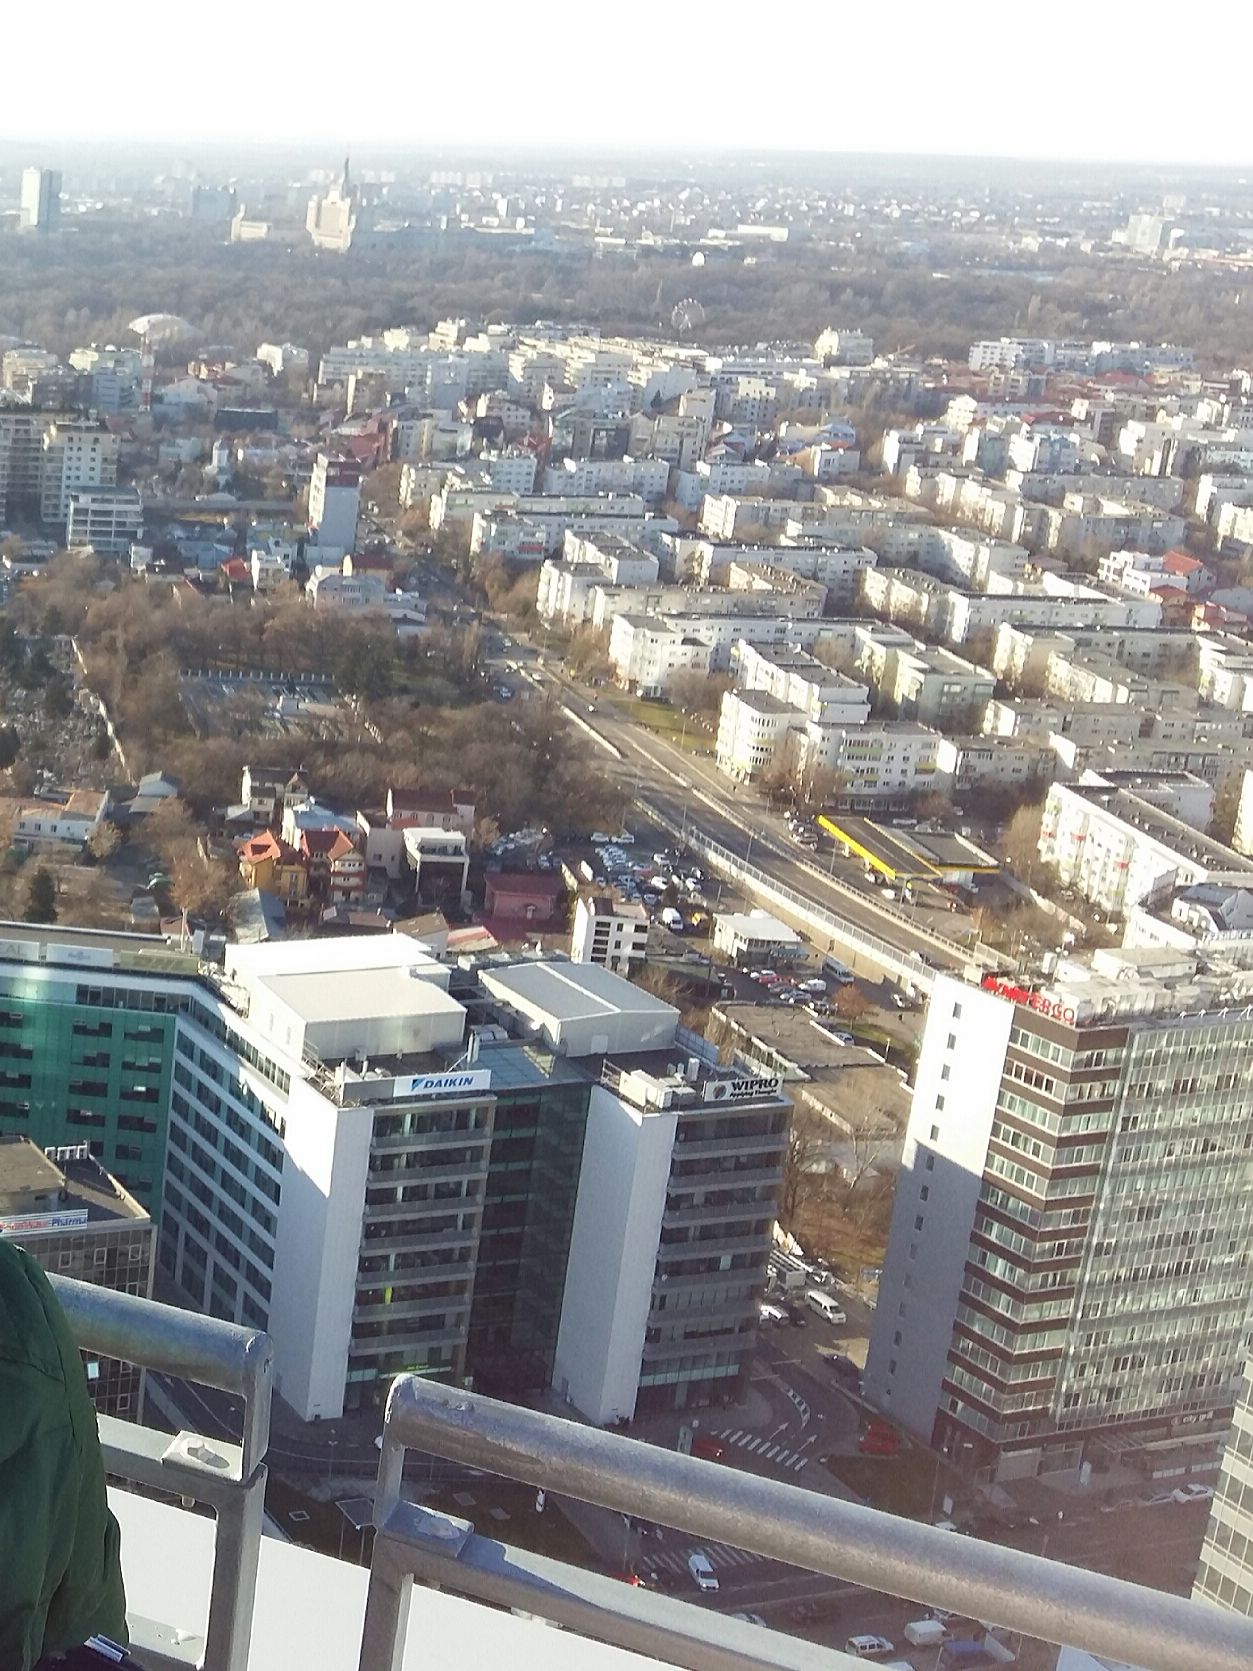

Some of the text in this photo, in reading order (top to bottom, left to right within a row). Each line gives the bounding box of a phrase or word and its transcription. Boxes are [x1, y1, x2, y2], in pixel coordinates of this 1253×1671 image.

[133, 956, 184, 971] DHL
[1031, 992, 1075, 1023] ERGO
[423, 1076, 474, 1089] DAIKIN
[731, 1078, 779, 1091] WIPRO
